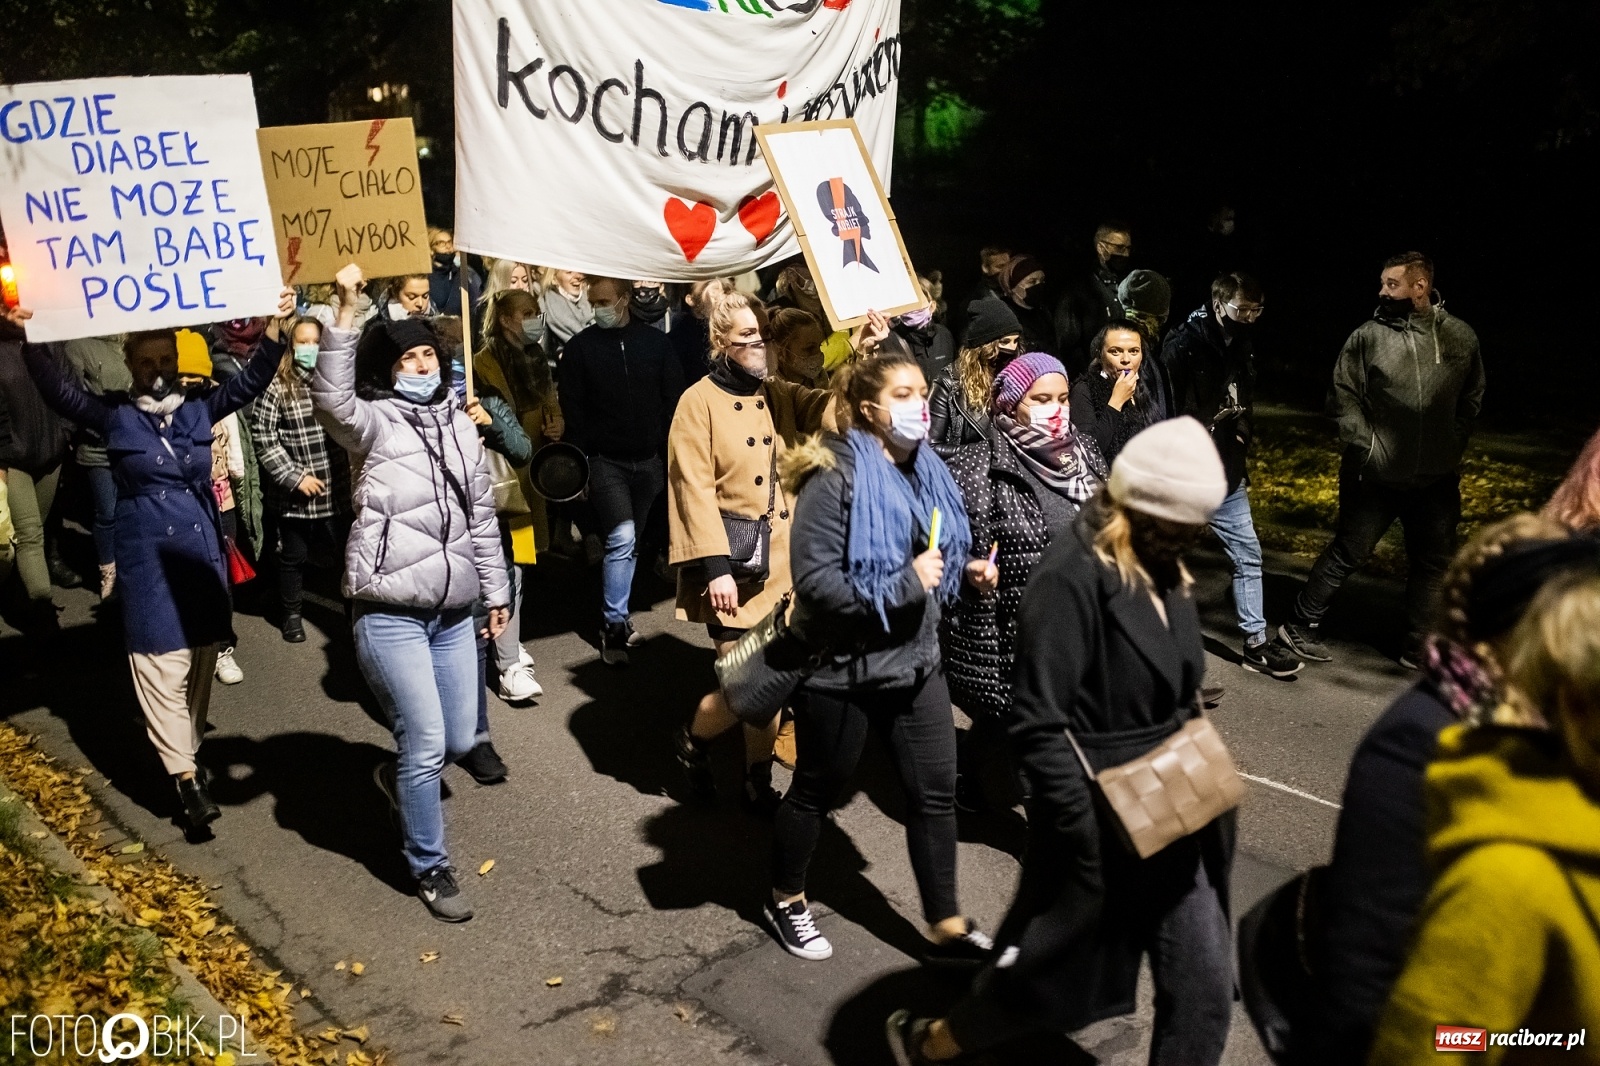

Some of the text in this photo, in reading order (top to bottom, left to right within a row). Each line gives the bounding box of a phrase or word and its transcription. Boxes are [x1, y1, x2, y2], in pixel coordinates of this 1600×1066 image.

[497, 17, 758, 166] kocham
[0, 94, 121, 144] GDZIE
[71, 131, 209, 175] DIABEŁ
[340, 167, 415, 199] CIAŁO
[26, 187, 88, 224] NIE
[831, 206, 857, 219] STRAJK
[836, 218, 861, 231] KOBIET
[36, 219, 265, 270] TAM BABĘ
[334, 219, 416, 256] WYBÓR
[81, 263, 228, 319] POŚLE
